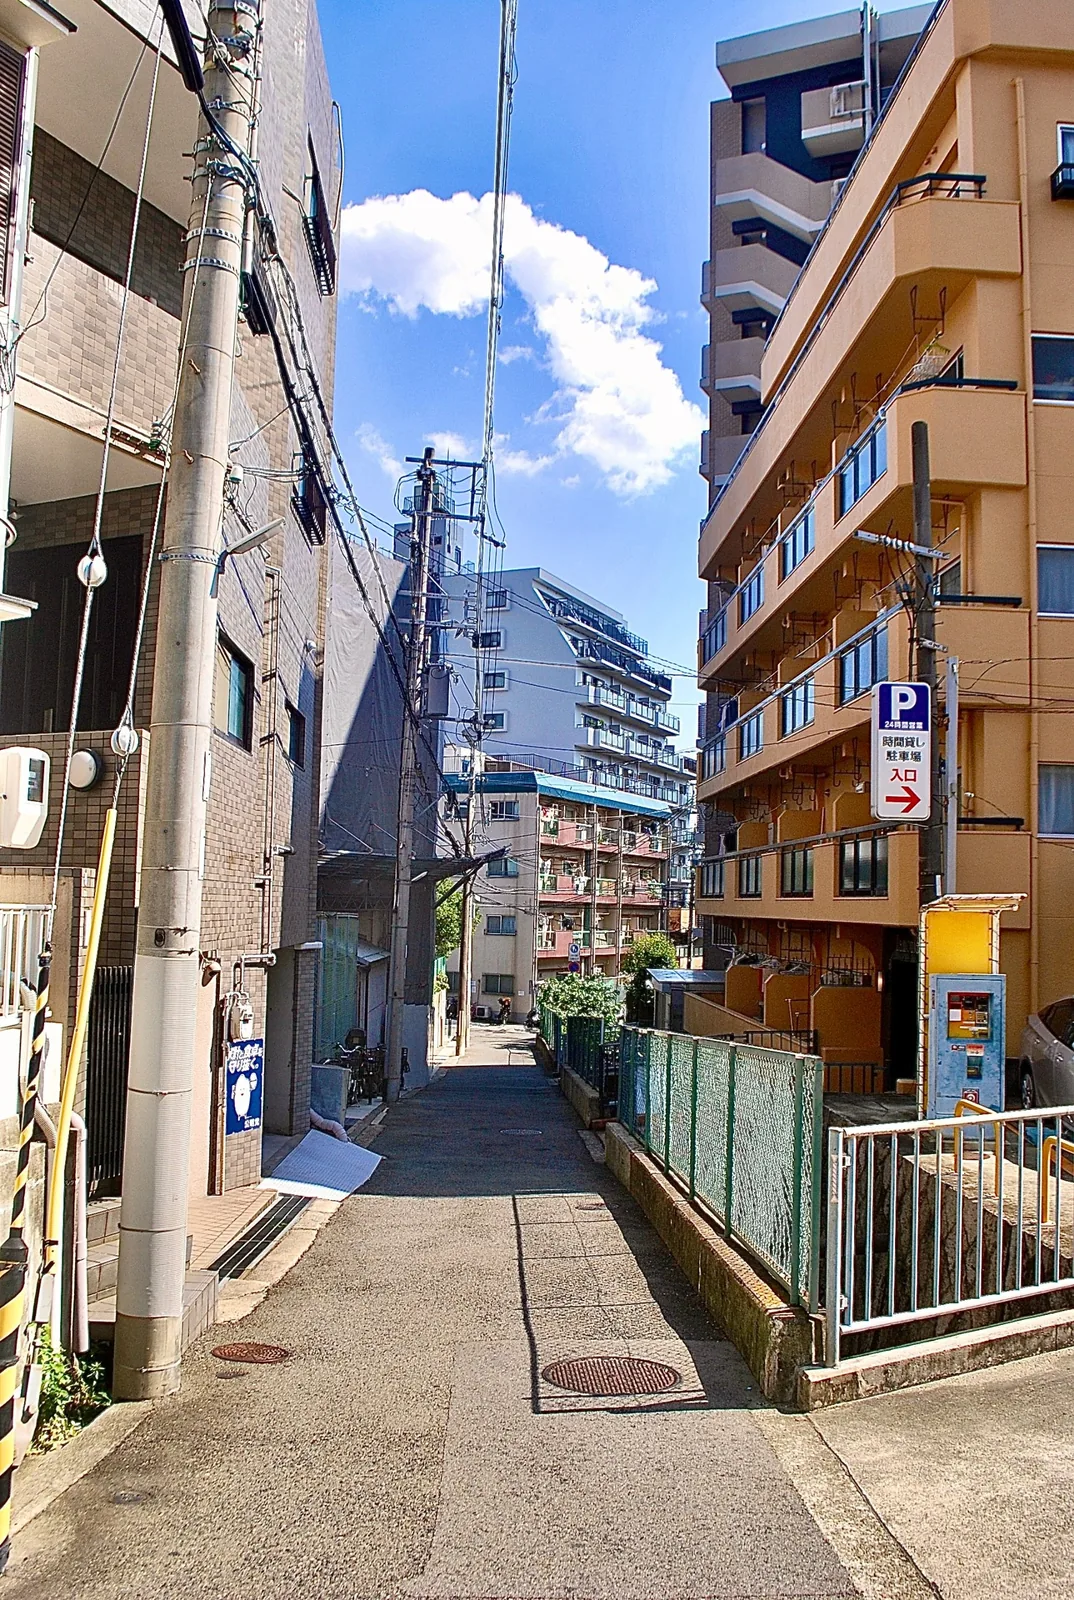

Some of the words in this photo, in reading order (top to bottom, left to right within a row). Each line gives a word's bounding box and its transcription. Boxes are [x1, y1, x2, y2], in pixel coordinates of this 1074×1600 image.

[890, 685, 917, 720] P
[884, 721, 923, 729] 24時間営業
[882, 736, 925, 748] 時間貸し
[885, 750, 922, 763] 駐車場
[890, 768, 917, 782] 入口
